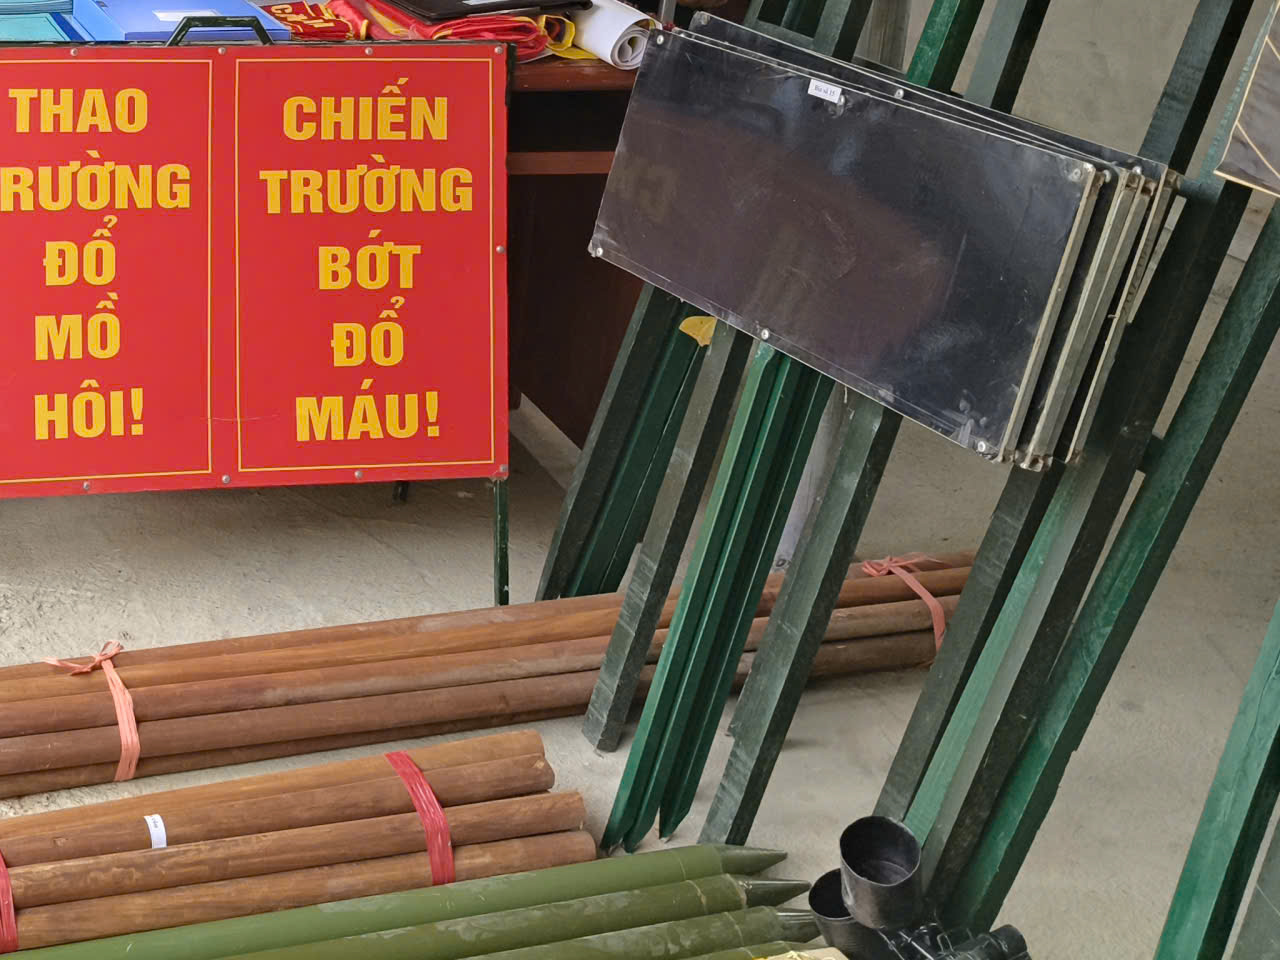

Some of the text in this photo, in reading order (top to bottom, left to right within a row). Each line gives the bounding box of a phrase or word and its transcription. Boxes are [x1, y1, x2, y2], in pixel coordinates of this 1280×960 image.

[8, 87, 148, 133] THAO
[283, 77, 448, 141] CHIẾN
[259, 153, 473, 214] TRƯỜNG
[42, 215, 118, 287] ĐỔ
[318, 229, 422, 290] BỚT
[34, 291, 121, 361] MỒ
[330, 295, 405, 367] ĐỔ
[34, 378, 144, 441] HÔI!
[295, 378, 440, 442] MÁU!
